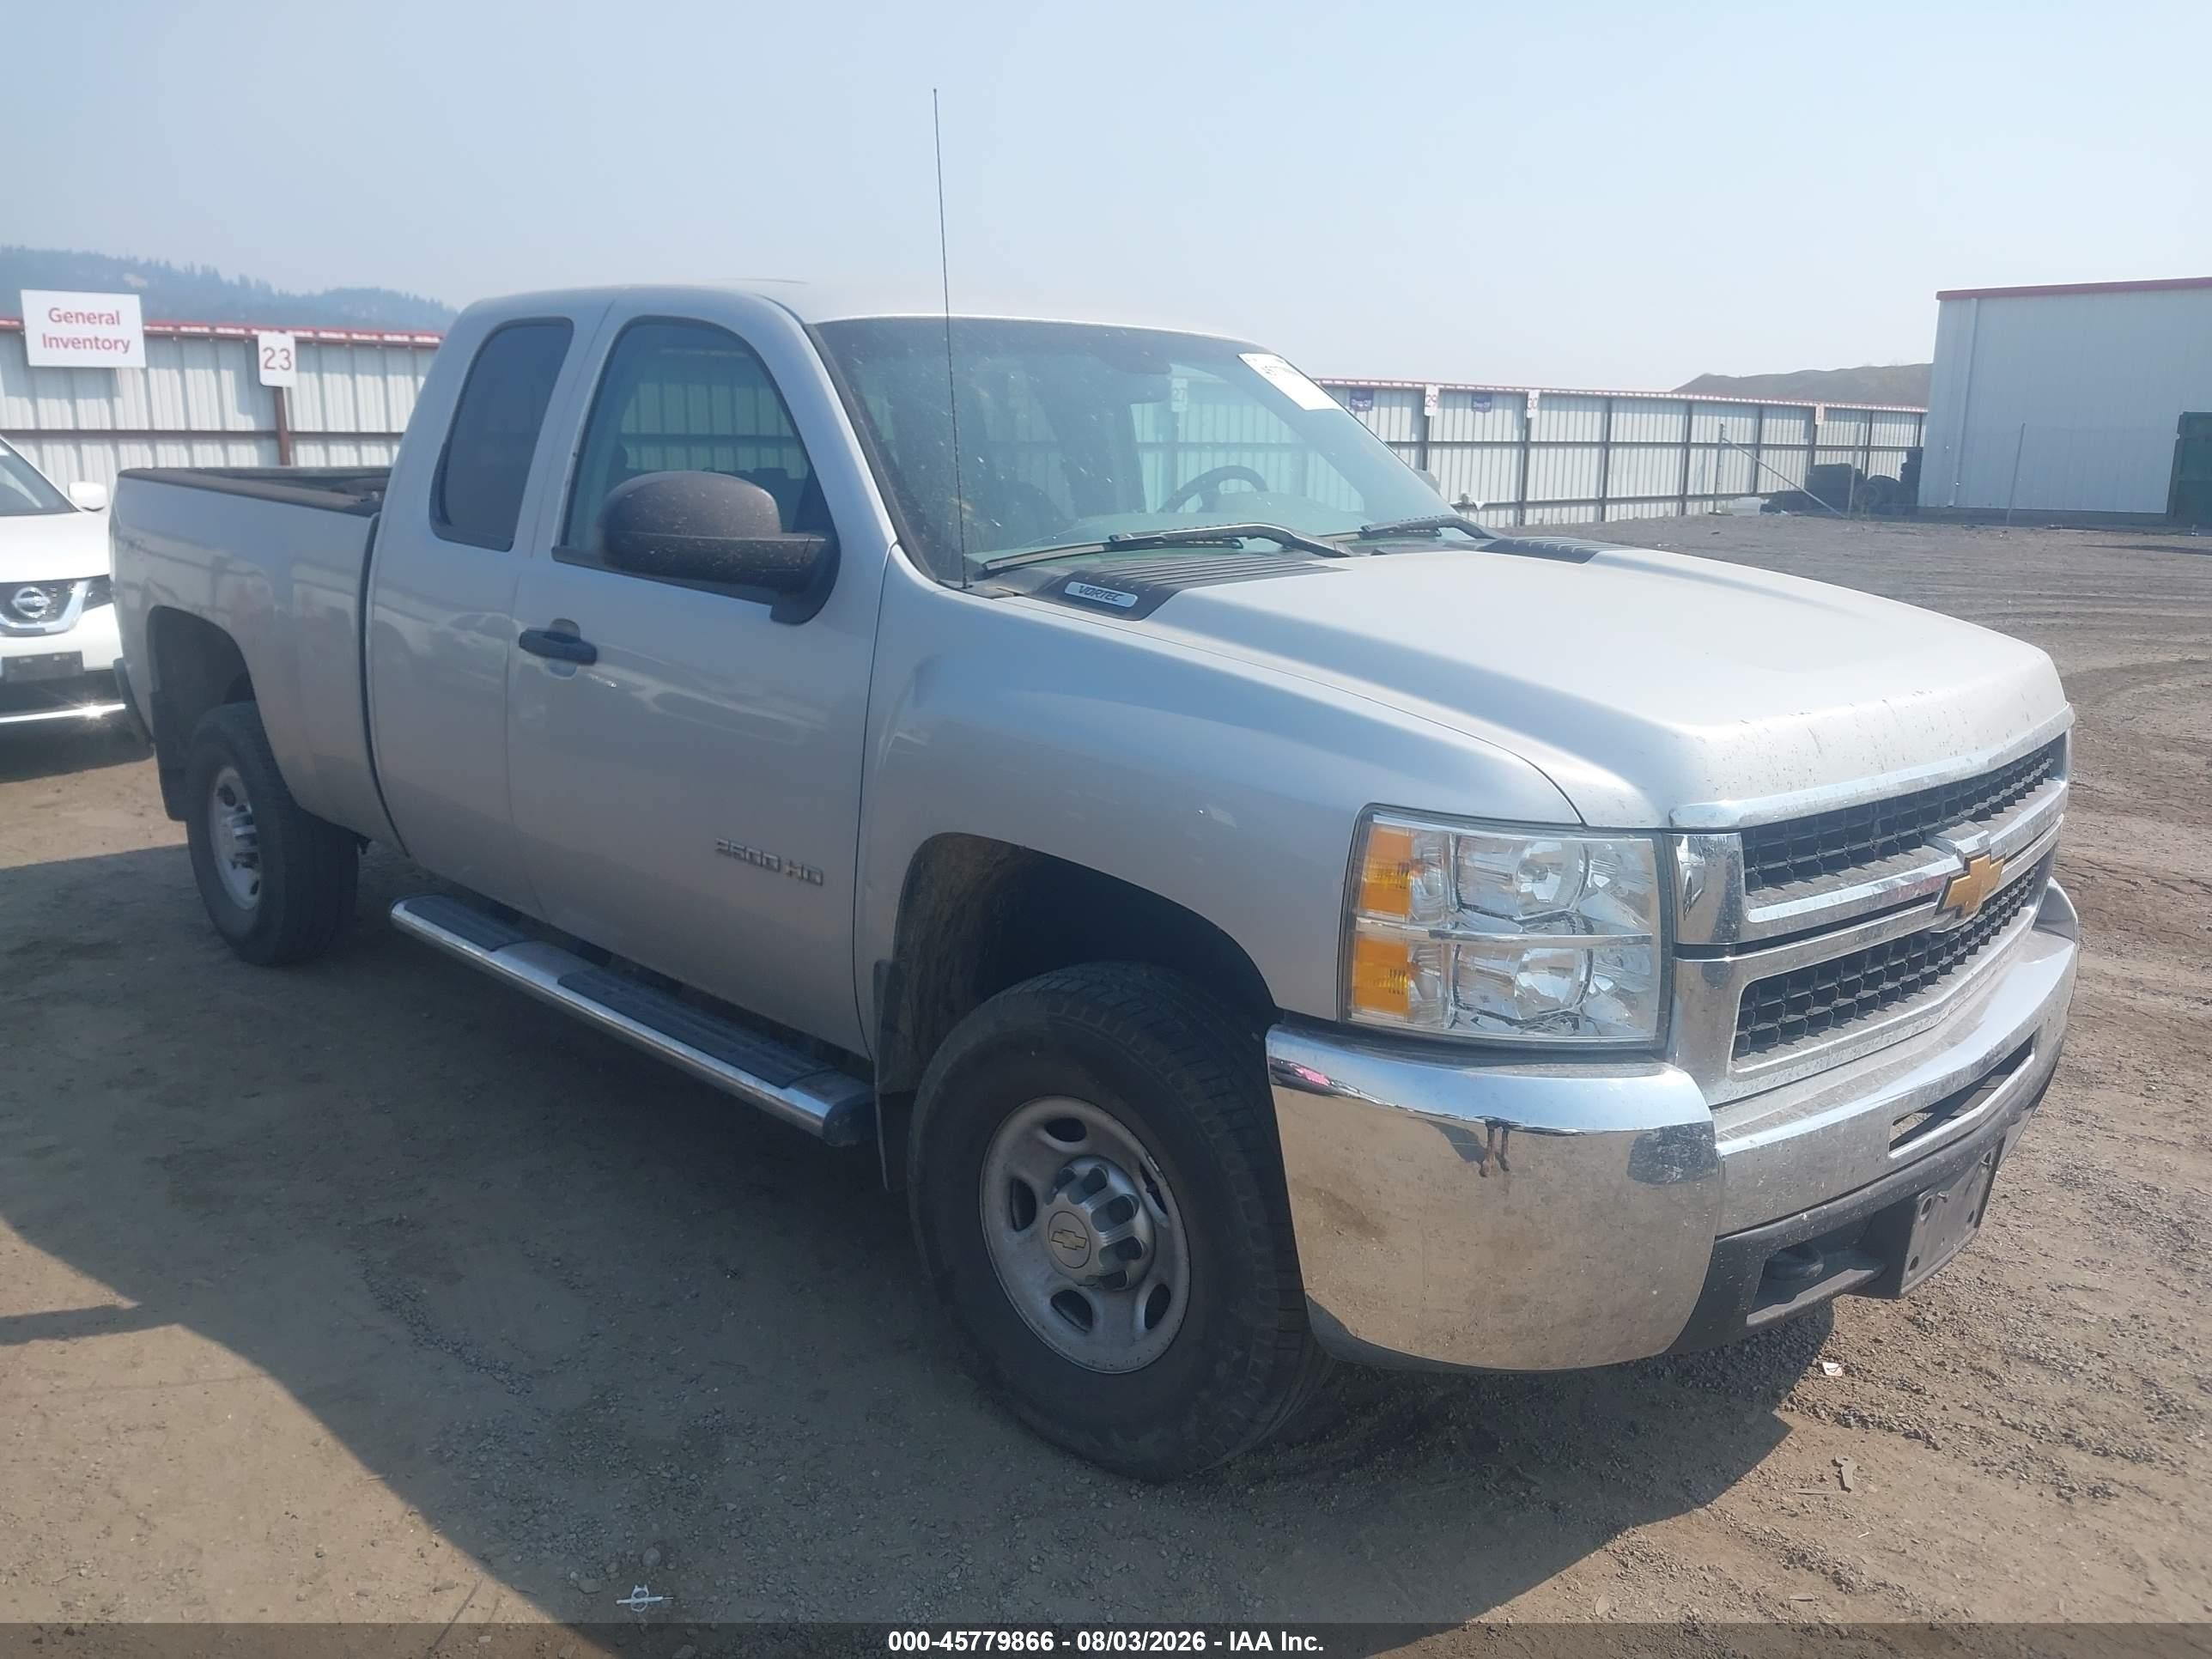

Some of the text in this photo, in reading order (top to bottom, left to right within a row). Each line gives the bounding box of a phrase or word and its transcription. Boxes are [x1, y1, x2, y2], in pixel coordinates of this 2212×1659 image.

[48, 307, 120, 325] General
[43, 333, 131, 354] Inventory
[262, 347, 292, 371] 23
[1078, 586, 1124, 601] VORTEC
[714, 837, 823, 886] 2500 HD
